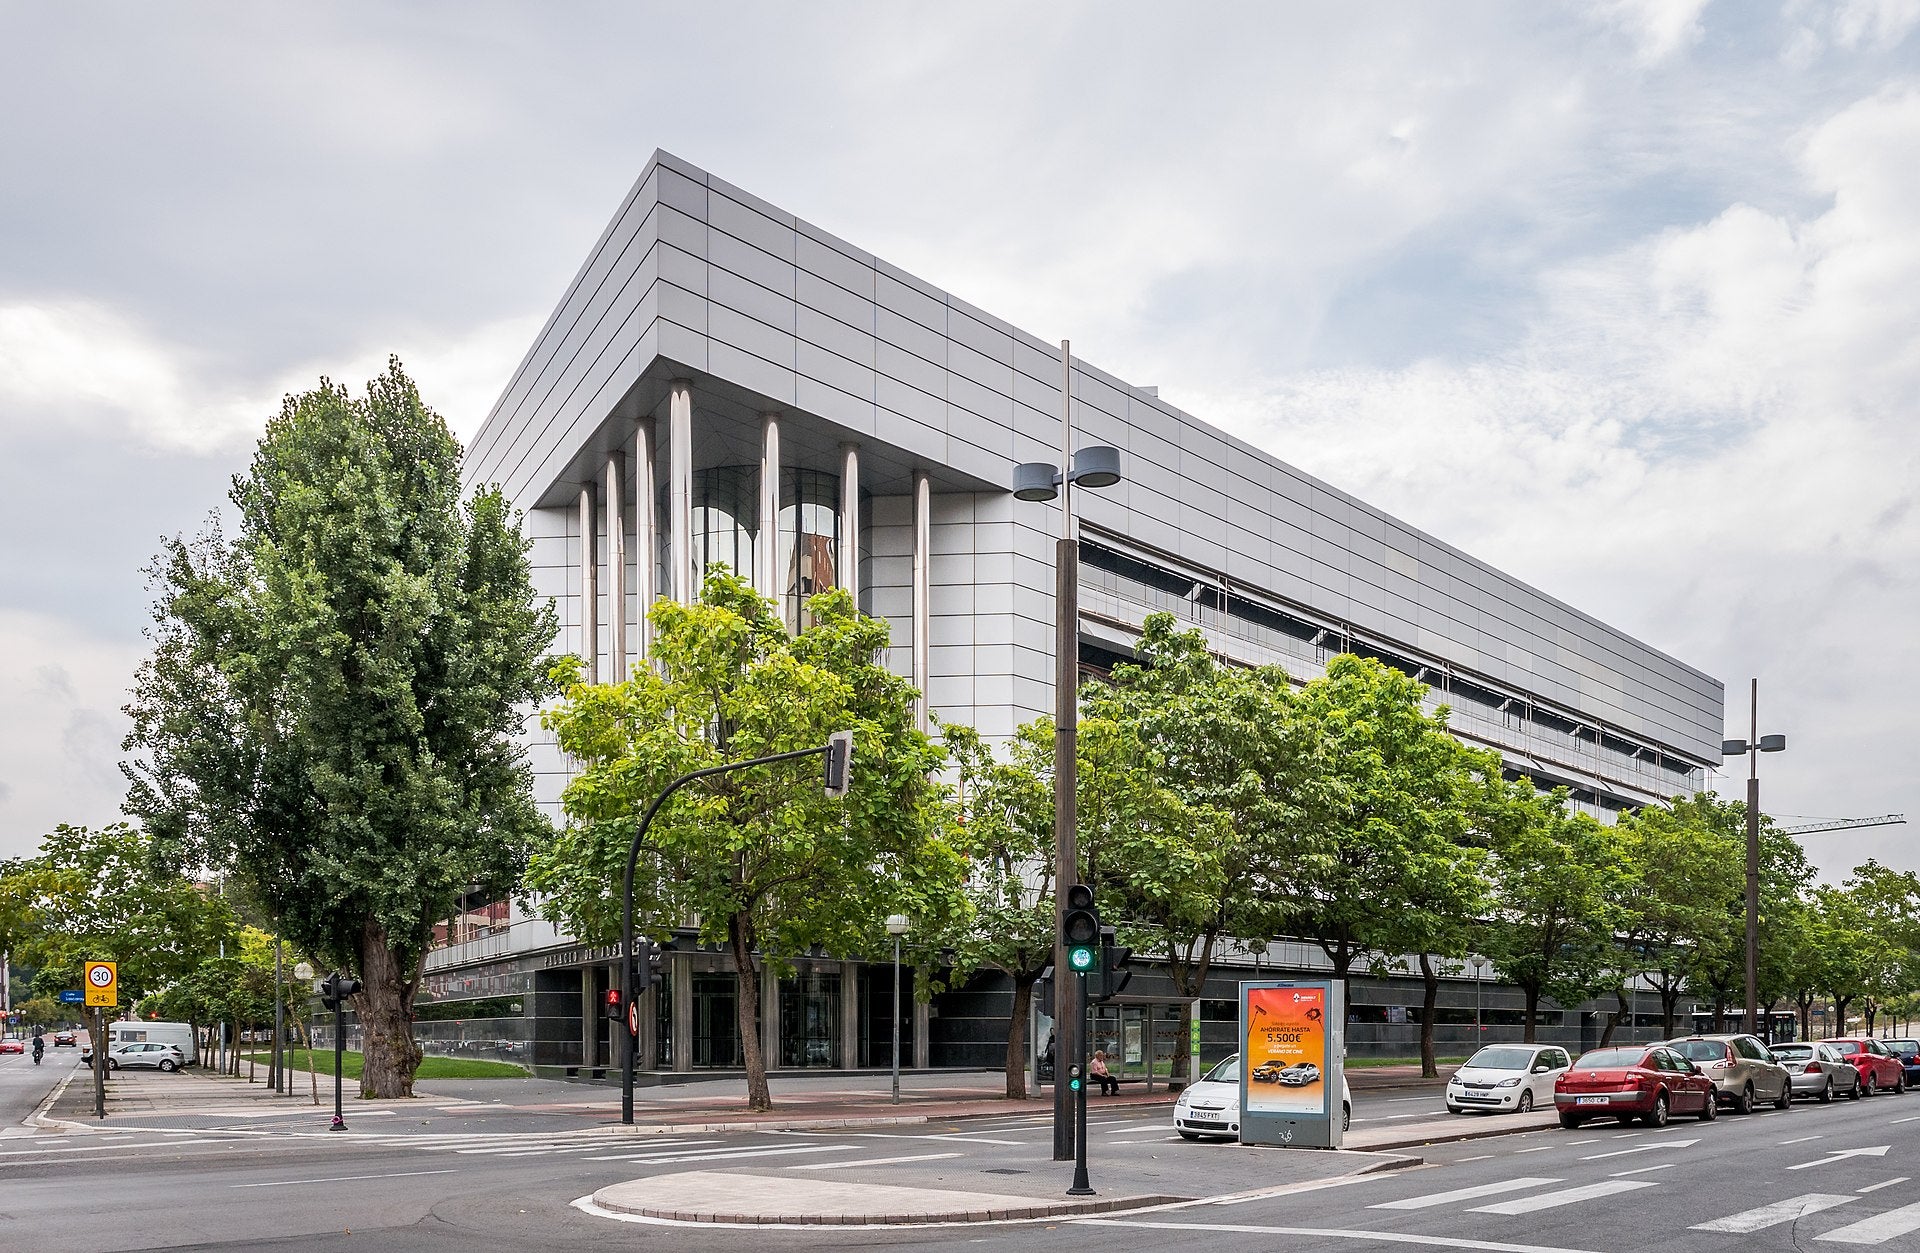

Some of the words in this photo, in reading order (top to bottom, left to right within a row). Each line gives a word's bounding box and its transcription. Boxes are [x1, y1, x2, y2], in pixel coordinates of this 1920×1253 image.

[544, 951, 577, 967] PALACIO
[584, 948, 592, 960] DE
[93, 971, 109, 981] 30
